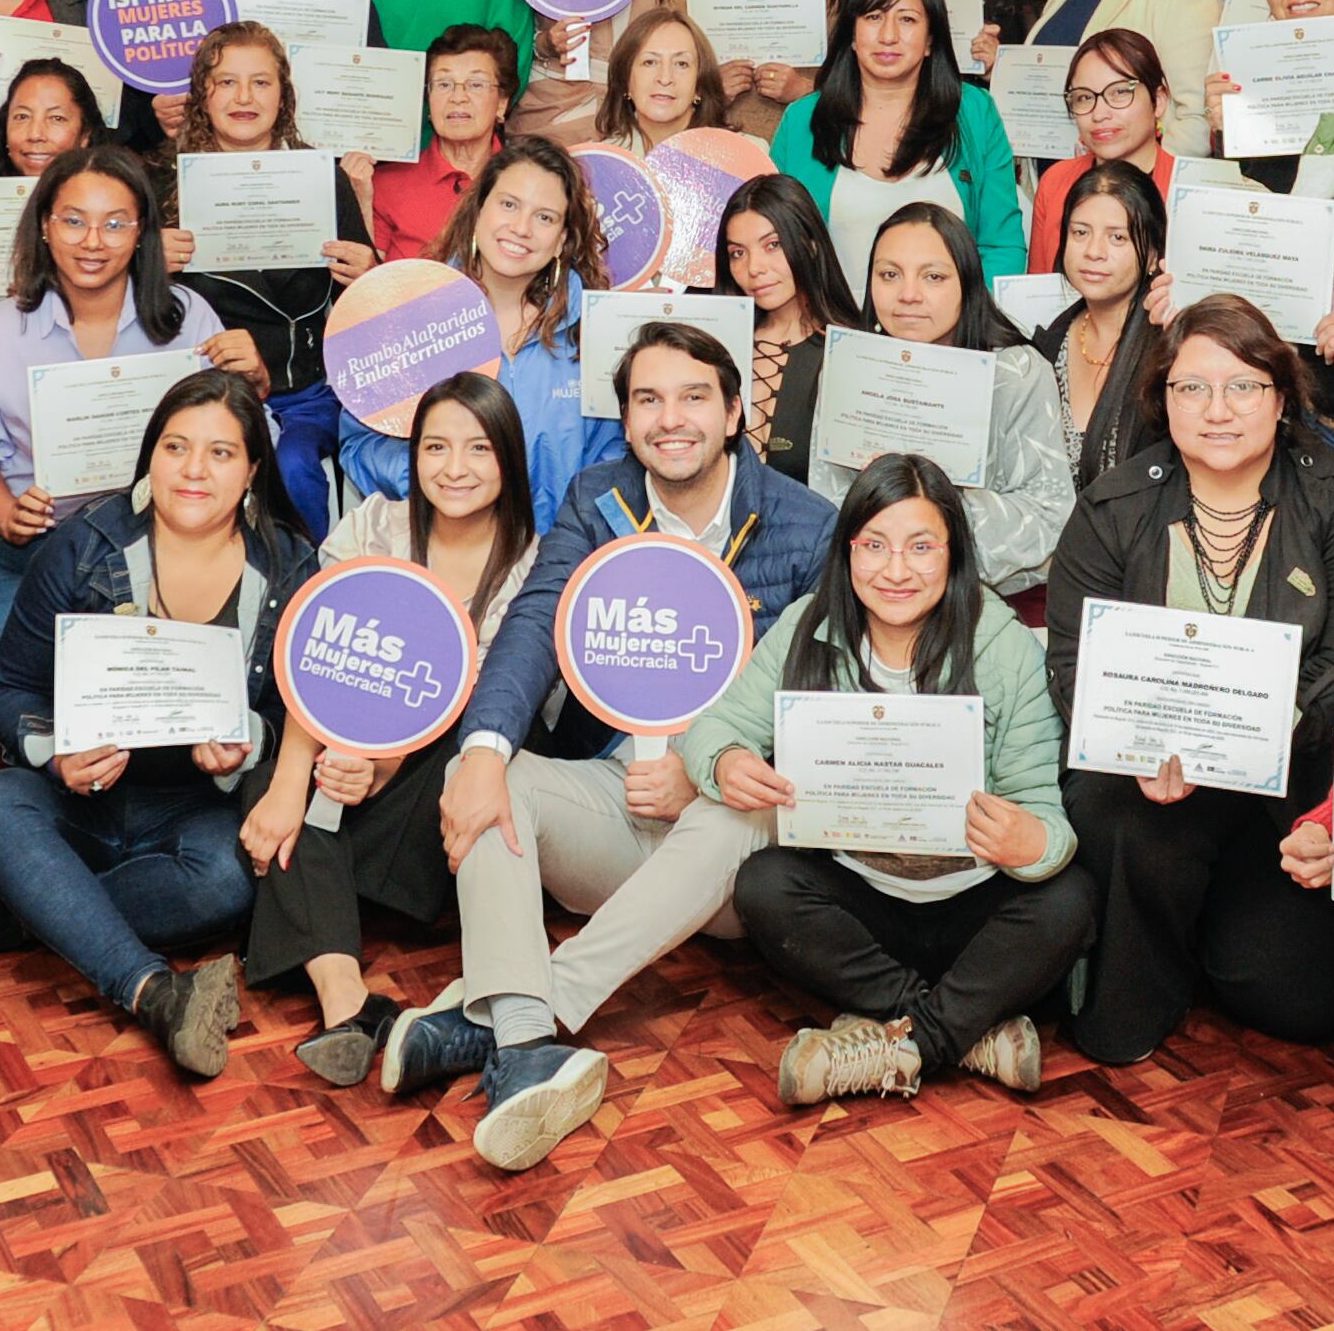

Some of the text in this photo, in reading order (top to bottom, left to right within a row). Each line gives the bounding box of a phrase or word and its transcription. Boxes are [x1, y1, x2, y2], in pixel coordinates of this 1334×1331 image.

[118, 0, 203, 26] MUJERES
[121, 19, 207, 45] PARA LA
[124, 39, 204, 63] POLÍTIC
[354, 322, 486, 390] EnlosTerritorios
[587, 597, 678, 635] Más
[310, 606, 406, 663] Más
[585, 631, 677, 655] Mujeres
[303, 638, 398, 682] Mujeres
[584, 650, 679, 669] Democracia
[299, 657, 392, 698] Democracia
[1141, 677, 1179, 687] CAROLINA
[1164, 705, 1192, 714] ESCUELA
